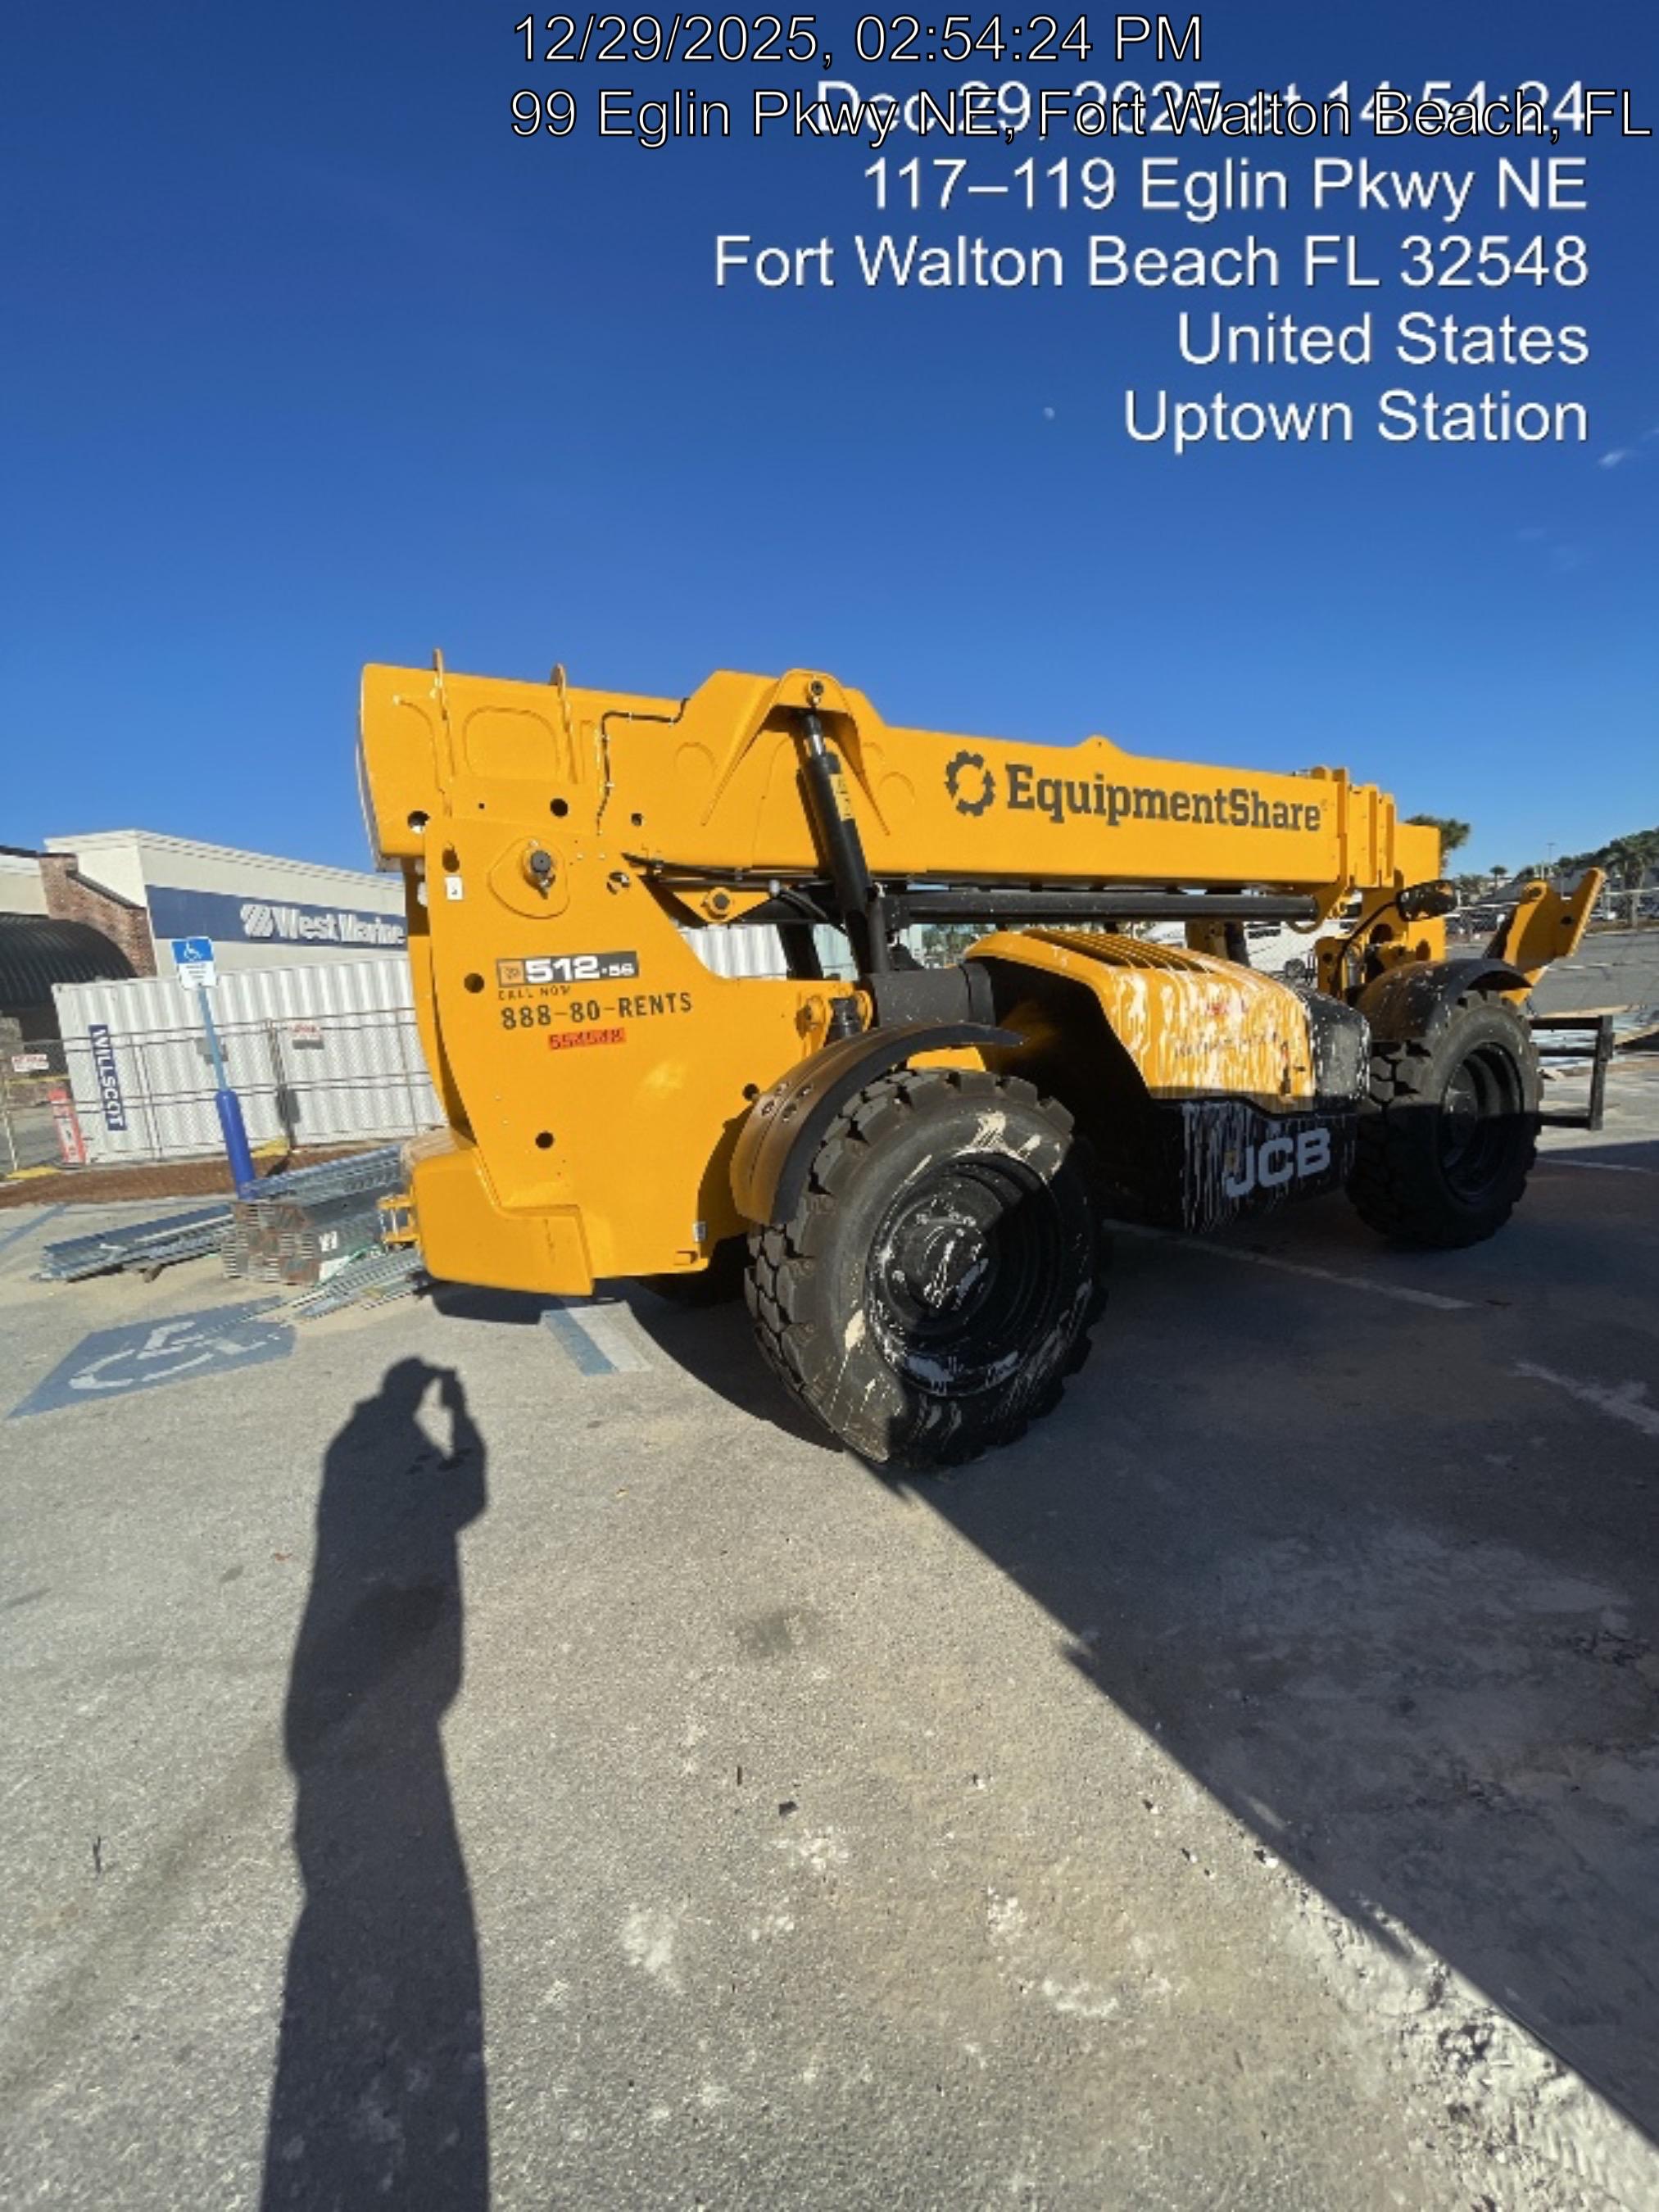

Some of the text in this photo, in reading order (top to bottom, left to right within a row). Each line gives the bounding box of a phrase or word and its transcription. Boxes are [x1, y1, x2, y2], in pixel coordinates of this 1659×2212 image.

[1005, 763, 1321, 831] EquipmentShare
[271, 906, 406, 945] West Marine
[498, 985, 571, 1000] CALL NOW
[501, 992, 692, 1030] 888-80-RENTS
[92, 1028, 124, 1127] WILLSCOT
[1224, 1127, 1331, 1198] JCB
